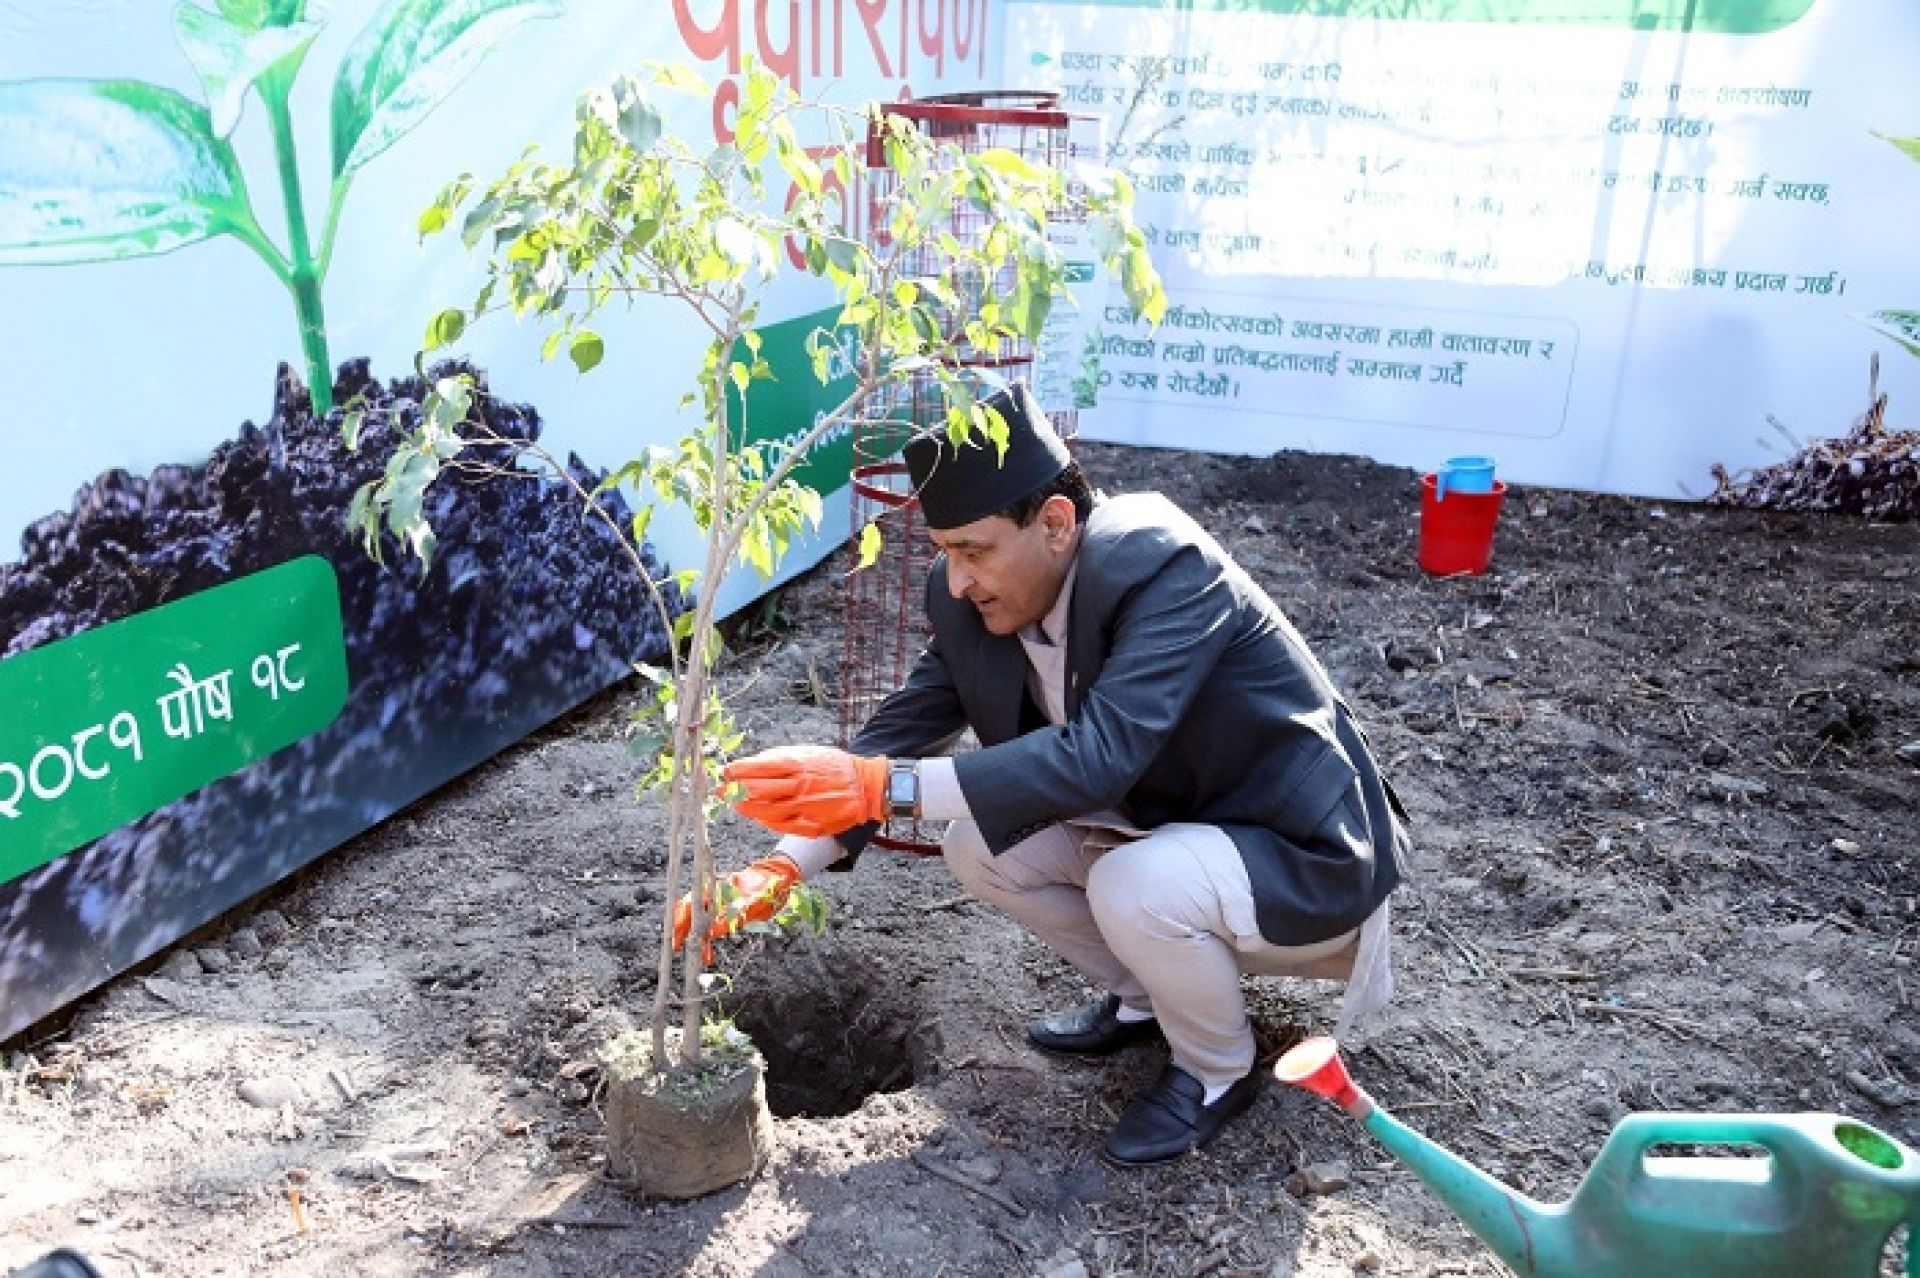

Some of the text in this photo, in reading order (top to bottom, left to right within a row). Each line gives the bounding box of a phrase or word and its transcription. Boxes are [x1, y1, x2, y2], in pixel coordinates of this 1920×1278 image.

[1292, 320, 1381, 344] अवसरमा
[1387, 325, 1434, 349] हामी
[1440, 331, 1533, 358] वातावरण
[1538, 340, 1555, 360] र
[0, 641, 306, 819] २०८१ पौष १८
